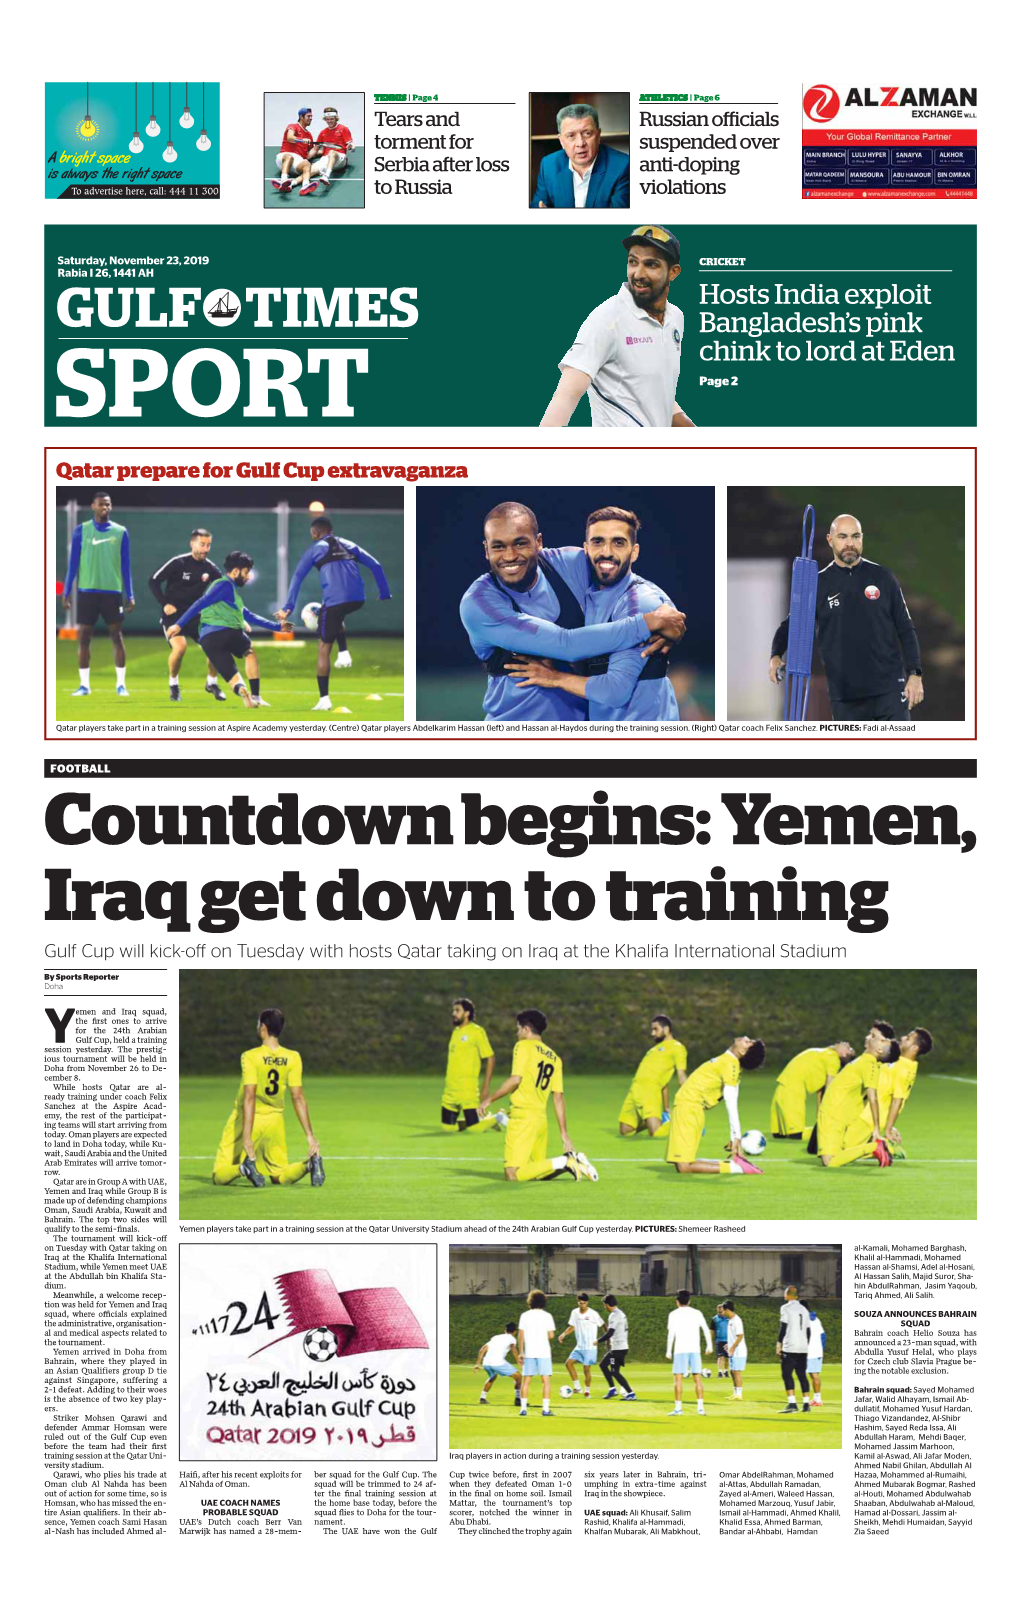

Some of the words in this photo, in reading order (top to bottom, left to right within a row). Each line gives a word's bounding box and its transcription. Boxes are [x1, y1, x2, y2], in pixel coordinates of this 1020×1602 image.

[412, 93, 432, 103] Page
[433, 93, 438, 102] 4
[694, 93, 713, 103] Page
[714, 93, 720, 102] 6
[845, 87, 977, 107] ALZAMAN
[374, 111, 423, 127] Tears
[426, 111, 460, 127] and
[639, 111, 709, 127] Russian
[712, 111, 779, 127] officials
[912, 109, 962, 119] EXCHANGE
[374, 135, 446, 149] torment
[449, 134, 474, 149] for
[640, 134, 737, 152] suspended
[740, 138, 780, 149] over
[827, 132, 845, 141] Your
[847, 132, 872, 141] Global
[875, 132, 920, 142] Remittance
[922, 132, 952, 141] Partner
[48, 151, 57, 163] A
[59, 151, 97, 167] bright
[97, 154, 131, 166] space
[374, 157, 430, 172] Serbia
[433, 157, 473, 172] after
[476, 157, 509, 172] loss
[640, 157, 740, 175] anti-doping
[48, 168, 59, 179] is
[61, 167, 99, 182] always
[102, 167, 119, 179] the
[122, 167, 151, 182] right
[151, 170, 183, 181] space
[71, 186, 81, 196] To
[84, 186, 123, 196] advertise
[126, 187, 146, 196] here,
[150, 186, 166, 196] call:
[169, 186, 185, 196] 444
[190, 187, 198, 196] 11
[202, 186, 218, 196] 300
[374, 180, 392, 194] to
[395, 179, 452, 194] Russia
[639, 179, 726, 194] violations
[58, 256, 107, 267] Saturday,
[110, 256, 165, 265] November
[166, 256, 181, 266] 23,
[184, 256, 209, 265] 2019
[699, 257, 746, 267] CRICKET
[58, 268, 87, 277] Rabia
[95, 268, 111, 278] 26,
[113, 268, 135, 277] 1441
[138, 268, 154, 277] AH
[699, 284, 769, 304] Hosts
[774, 284, 840, 304] India
[845, 284, 932, 309] exploit
[57, 286, 202, 328] GULF
[245, 286, 419, 328] TIMES
[866, 312, 923, 337] pink
[700, 340, 771, 361] chink
[776, 341, 801, 361] to
[806, 340, 856, 361] lord
[861, 341, 885, 361] at
[890, 340, 955, 361] Eden
[56, 348, 368, 418] SPORT
[700, 376, 729, 388] Page
[731, 376, 738, 386] 2
[56, 462, 114, 480] Qatar
[117, 466, 200, 481] prepare
[203, 462, 233, 478] for
[236, 462, 280, 478] Gulf
[283, 462, 325, 481] Cup
[327, 463, 468, 482] extravaganza
[829, 599, 840, 609] FS
[50, 764, 111, 774] FOOTBALL
[45, 792, 454, 845] Countdown
[461, 790, 711, 858] begins:
[721, 793, 977, 853] Yemen,
[45, 868, 191, 932] Iraq
[198, 871, 306, 933] get
[316, 868, 514, 921] down
[524, 871, 595, 921] to
[606, 866, 889, 933] training
[45, 944, 77, 958] Gulf
[82, 944, 114, 961] Cup
[120, 944, 144, 957] will
[151, 944, 206, 958] kick-off
[211, 947, 231, 958] on
[237, 944, 304, 961] Tuesday
[310, 944, 343, 958] with
[350, 944, 392, 958] hosts
[398, 944, 442, 959] Qatar
[447, 944, 496, 961] taking
[502, 947, 522, 958] on
[529, 944, 557, 961] Iraq
[564, 945, 578, 958] at
[584, 944, 609, 958] the
[616, 944, 668, 958] Khalifa
[675, 944, 774, 958] International
[781, 944, 846, 958] Stadium
[44, 973, 55, 982] By
[56, 973, 82, 982] Sports
[83, 973, 119, 982] Reporter
[45, 982, 63, 990] Doha
[263, 1056, 288, 1066] YEMEN
[265, 1069, 279, 1096] 3
[536, 1060, 554, 1091] 18
[854, 1310, 883, 1318] SOUZA
[884, 1310, 937, 1318] ANNOUNCES
[938, 1310, 977, 1318] BAHRAIN
[901, 1319, 930, 1329] SQUAD
[233, 1371, 280, 1396] العربي
[283, 1371, 338, 1396] الخليج
[342, 1368, 378, 1392] كأس
[381, 1374, 415, 1394] دورة
[207, 1399, 246, 1416] 24th
[250, 1398, 327, 1418] Arabian
[332, 1398, 375, 1417] Gulf
[378, 1400, 415, 1420] Cup
[206, 1425, 261, 1444] Qatar
[267, 1427, 316, 1444] 2019
[372, 1424, 415, 1448] قطر
[450, 1451, 464, 1461] Iraq
[466, 1451, 493, 1461] players
[495, 1452, 501, 1460] in
[503, 1452, 526, 1460] action
[529, 1452, 553, 1461] during
[561, 1452, 590, 1461] training
[592, 1452, 619, 1460] session
[622, 1452, 659, 1461] yesterday.
[201, 1499, 218, 1507] UAE
[220, 1499, 248, 1507] COACH
[251, 1499, 280, 1507] NAMES
[203, 1508, 247, 1516] PROBABLE
[249, 1508, 278, 1517] SQUAD
